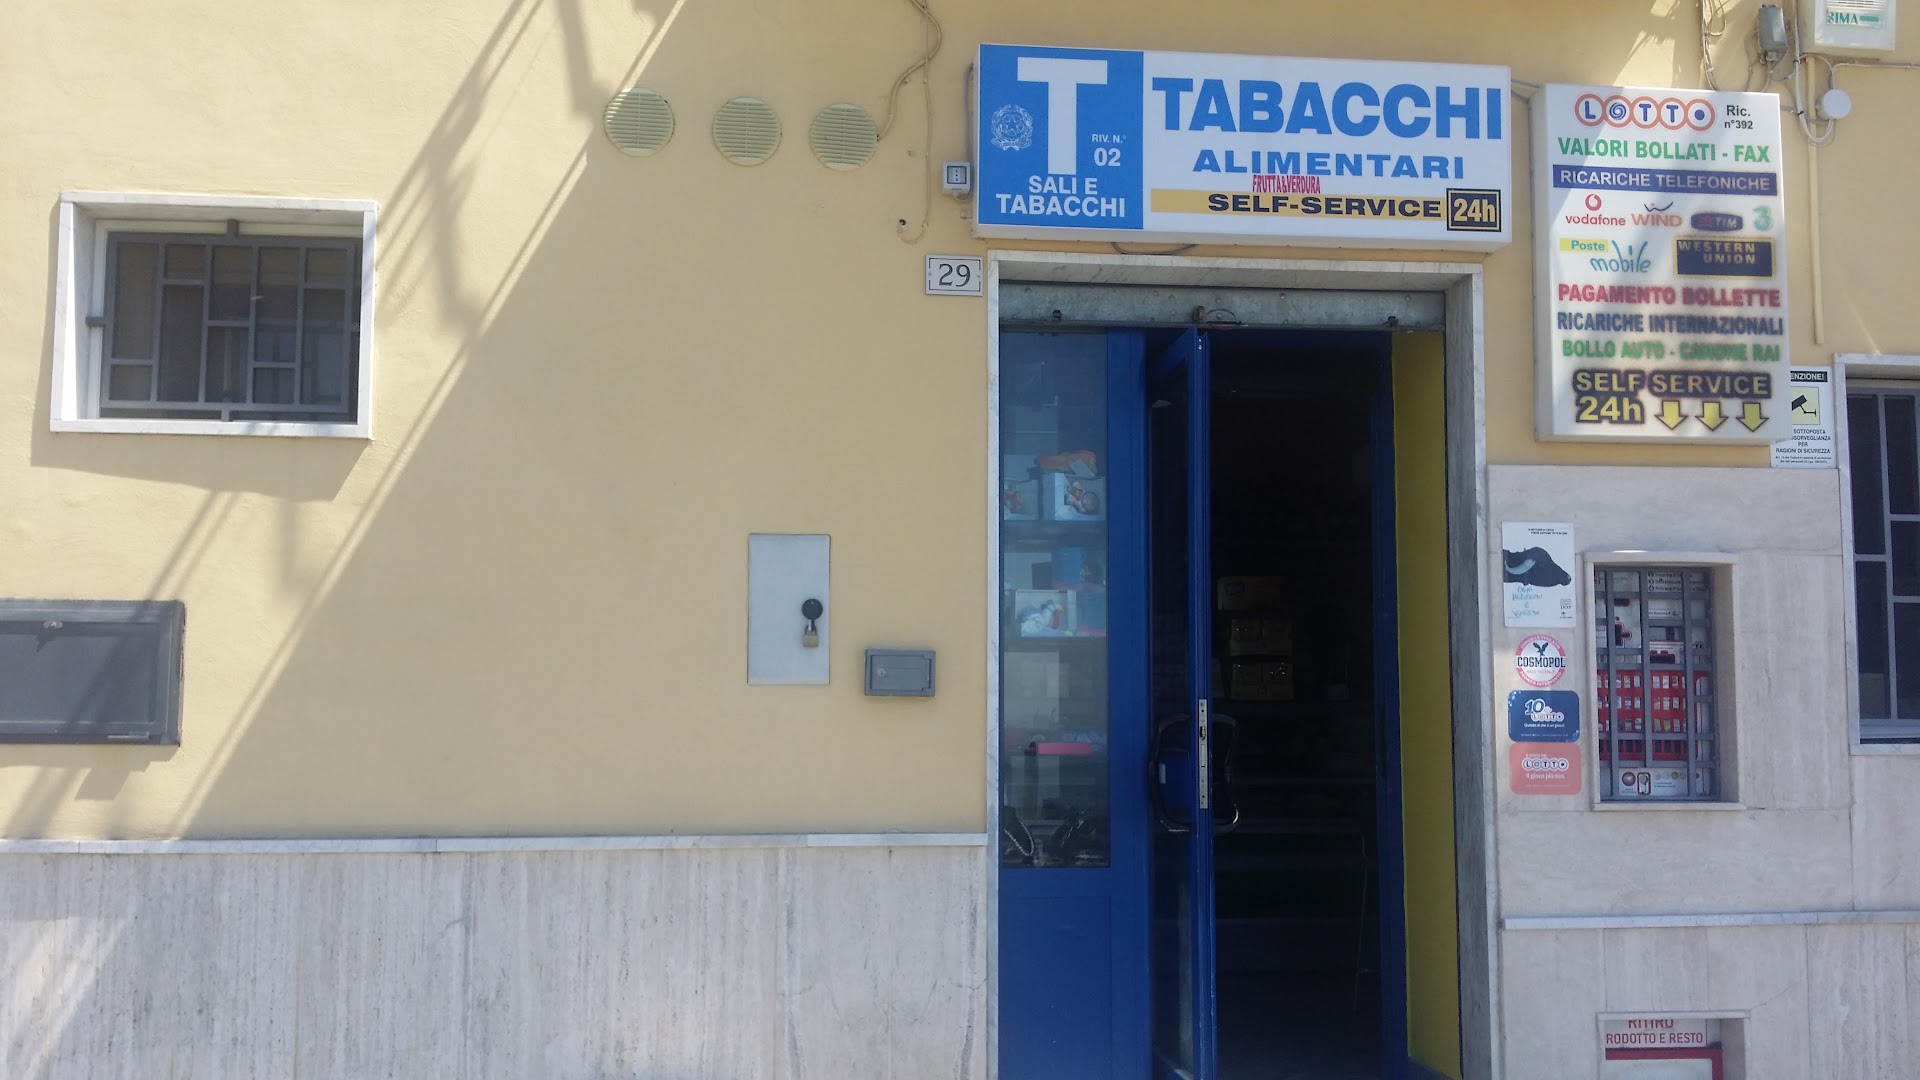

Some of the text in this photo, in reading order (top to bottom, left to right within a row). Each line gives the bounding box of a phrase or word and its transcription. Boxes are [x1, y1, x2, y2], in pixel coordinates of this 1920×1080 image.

[1017, 56, 1107, 175] T
[1152, 76, 1501, 140] TABACCHI
[1577, 95, 1713, 129] LOTTO
[1726, 105, 1750, 116] Ric.
[1724, 120, 1753, 129] n°392
[1092, 134, 1110, 143] RIV.
[1094, 147, 1121, 167] 02
[1558, 137, 1628, 157] VALORI
[1636, 140, 1715, 160] BOLLATI
[1734, 145, 1770, 162] FAX
[1193, 149, 1464, 179] ALIMENTARI
[1029, 175, 1097, 194] SALI E
[1252, 174, 1321, 194] FRUTTA&VERDURA
[1561, 170, 1770, 191] RICARICHE TELEFONICHE
[996, 194, 1125, 217] TABACCHI
[1208, 193, 1442, 218] SELF-SERVICE
[1453, 197, 1496, 224] 24h
[1565, 205, 1773, 231] vodafone WIND TIM 3
[1572, 240, 1605, 250] Poste
[1678, 241, 1755, 253] WESTERN
[1590, 240, 1650, 273] mobile
[1704, 254, 1756, 264] UNION
[938, 264, 970, 287] 29
[1558, 284, 1780, 307] PAGAMENTO BOLLETTE
[1558, 312, 1783, 335] RICARICHE INTERNAZIONALI
[1563, 340, 1615, 357] BOLLO
[1621, 342, 1665, 359] AUTO
[1680, 343, 1747, 360] CANONE
[1753, 345, 1779, 361] RAI
[1576, 372, 1768, 394] SELF SERVICE
[1579, 396, 1641, 421] 24h
[1518, 657, 1565, 667] COSMOPOL
[1525, 698, 1545, 715] 10
[1531, 712, 1564, 722] LOTTO
[1522, 758, 1569, 771] LOTTO
[1606, 1033, 1703, 1043] RODOTTO E RESTO
